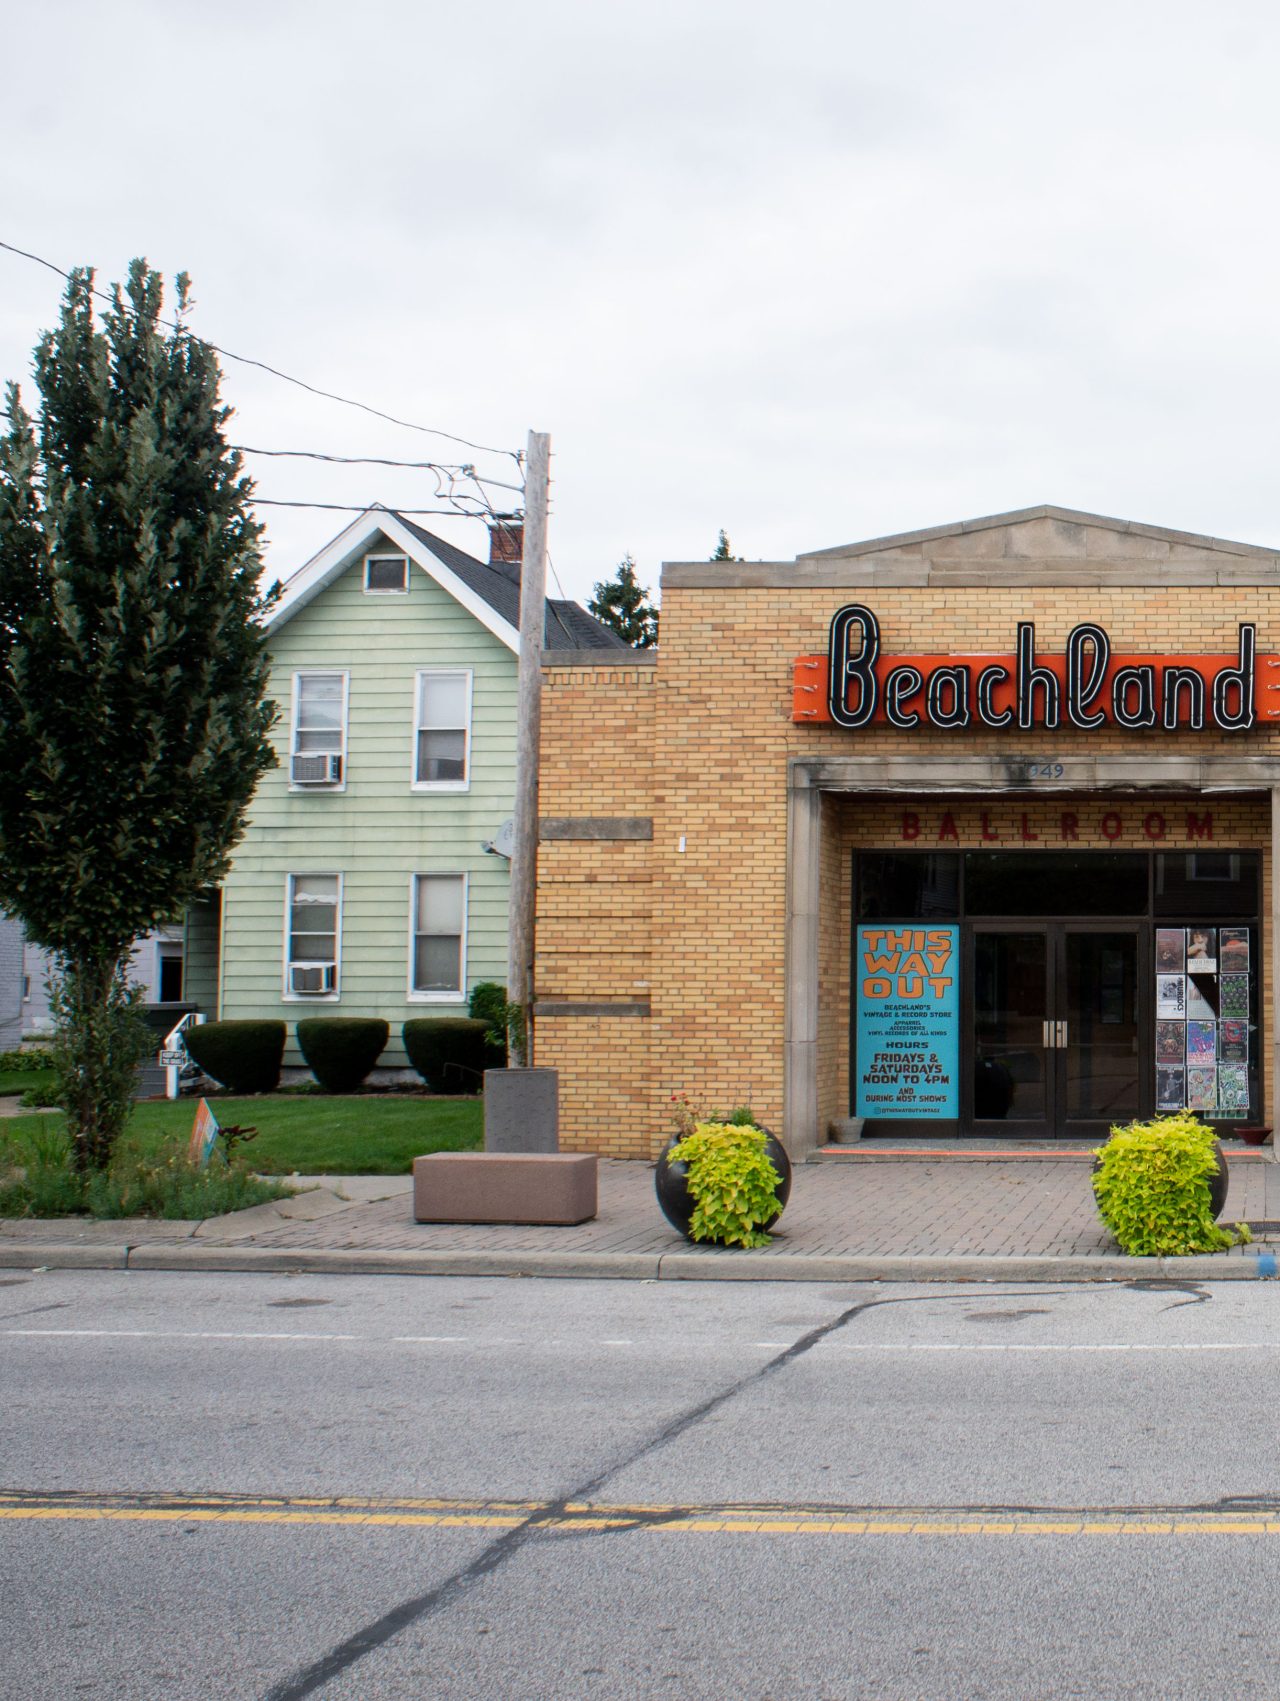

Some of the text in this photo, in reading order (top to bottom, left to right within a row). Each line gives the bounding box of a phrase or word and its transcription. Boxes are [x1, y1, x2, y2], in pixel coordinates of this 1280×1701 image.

[827, 603, 1258, 730] Beachland
[902, 812, 1214, 841] BALLROOM
[862, 929, 952, 952] THIS
[863, 951, 953, 977] WAY
[863, 976, 952, 999] OUT
[870, 1064, 942, 1074] SATURDAYS
[874, 1053, 938, 1063] FRIDAYS &
[863, 1074, 949, 1084] NOON TO 4PM
[898, 1087, 914, 1095] AND
